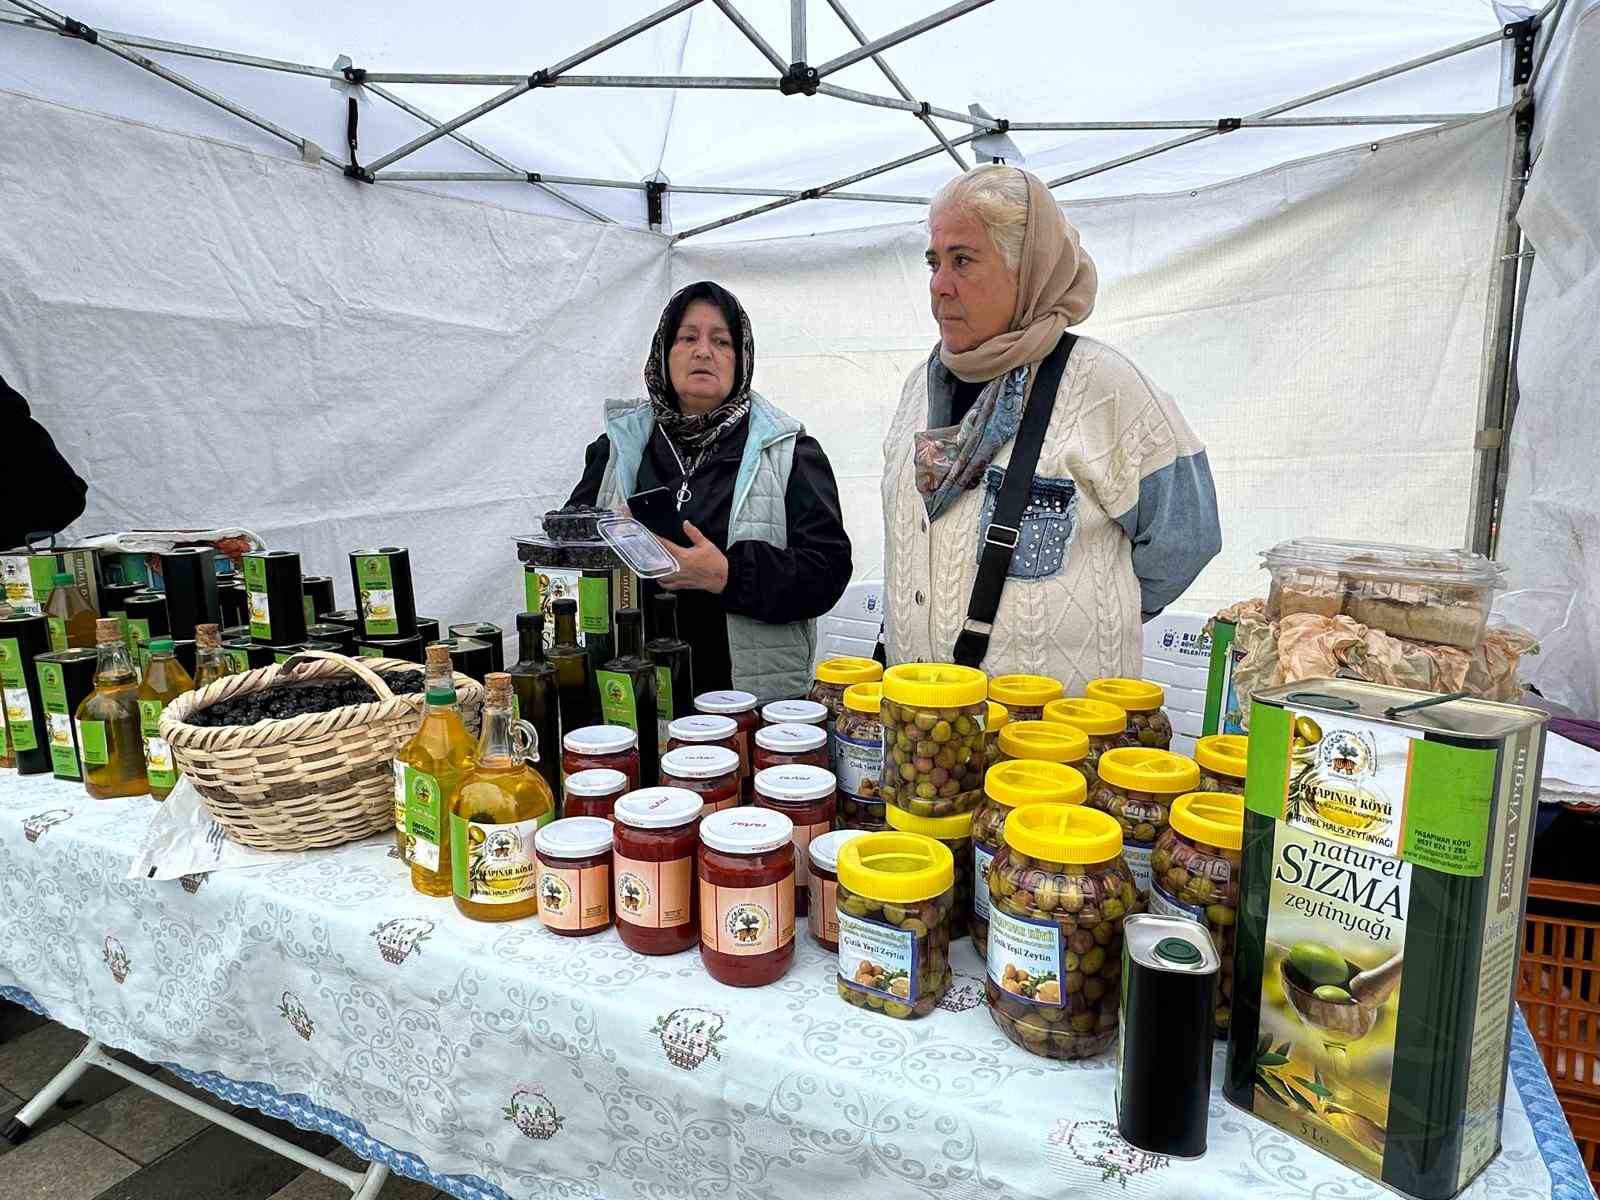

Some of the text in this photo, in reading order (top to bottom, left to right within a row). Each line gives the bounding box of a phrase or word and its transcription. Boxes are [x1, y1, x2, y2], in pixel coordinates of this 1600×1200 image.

[1183, 632, 1213, 644] BUS
[1360, 797, 1392, 816] KÖYÜ
[1500, 747, 1527, 899] Extra Virgin
[1313, 840, 1404, 880] naturel
[1275, 844, 1404, 921] SIZMA
[1285, 893, 1392, 941] zeytinyağı
[880, 947, 905, 960] Zeytin
[1024, 948, 1052, 962] Zeytin
